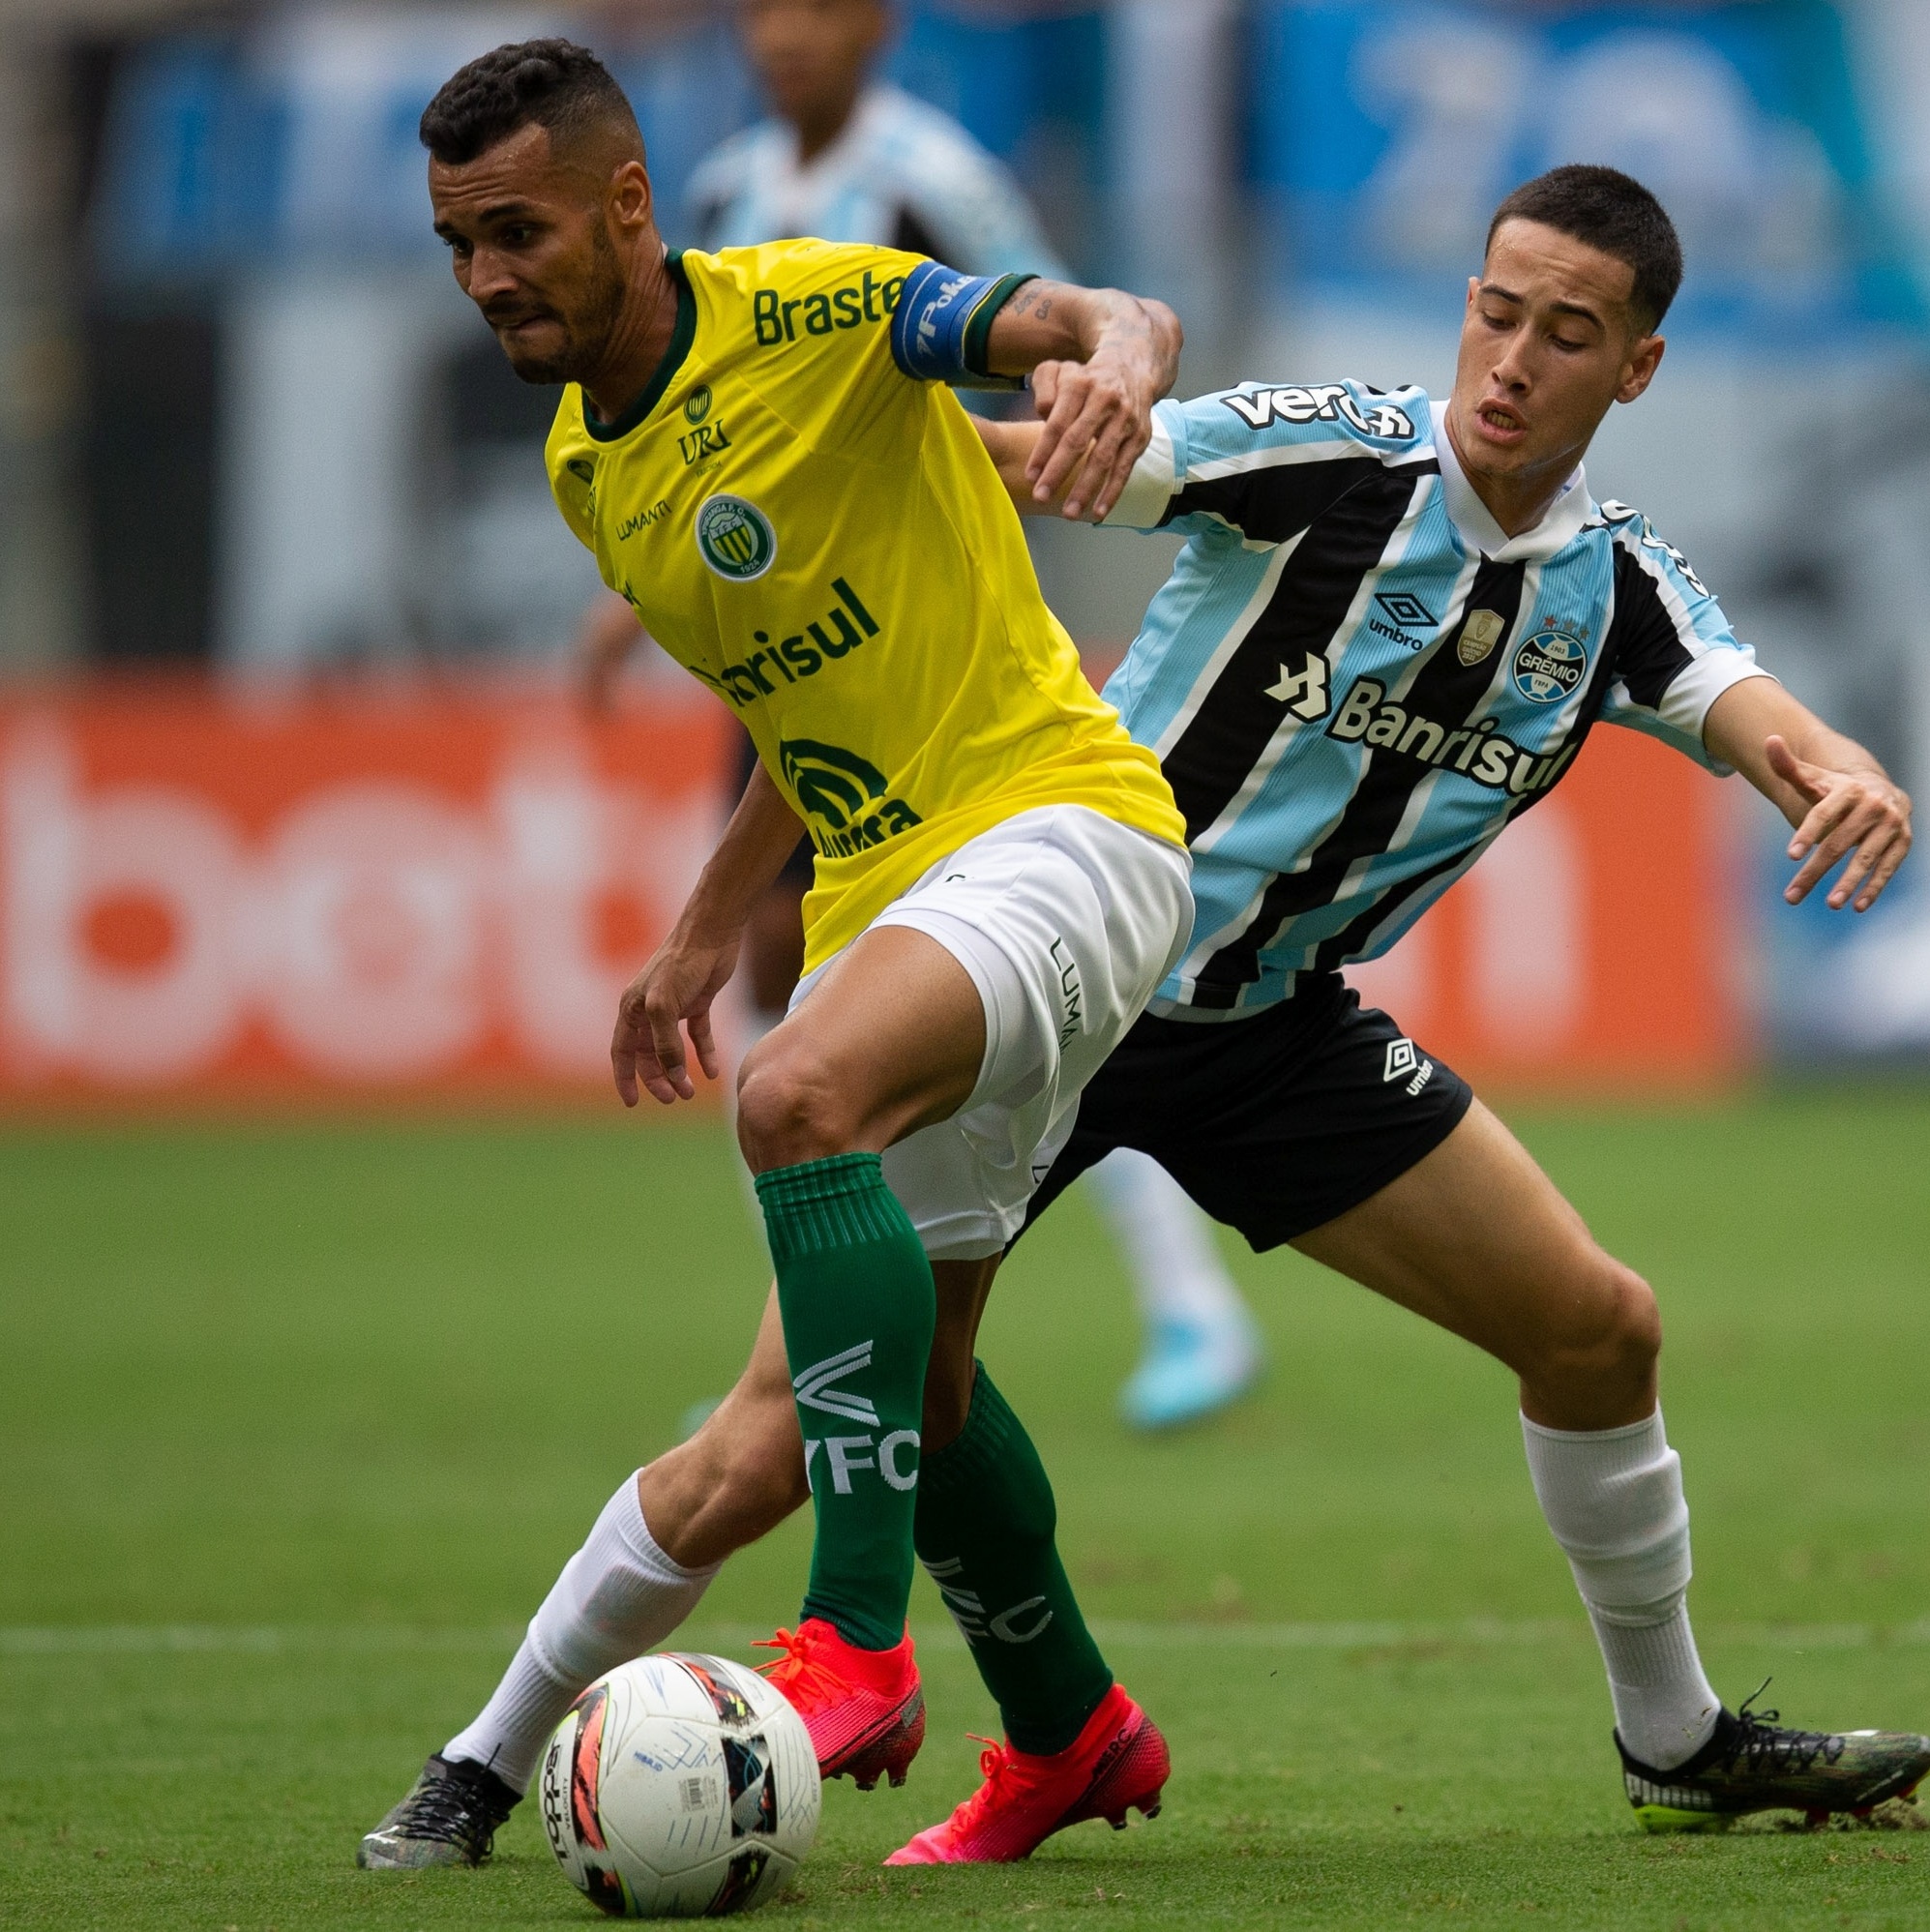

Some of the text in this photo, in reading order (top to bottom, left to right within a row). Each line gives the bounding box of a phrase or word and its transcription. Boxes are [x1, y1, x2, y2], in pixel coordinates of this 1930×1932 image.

[677, 418, 732, 466] URI
[616, 499, 672, 542] LUMANTI
[1369, 618, 1424, 651] umbro
[1550, 644, 1566, 655] 1903
[1519, 652, 1579, 683] GRÊMIO
[1327, 675, 1578, 794] Banrisul
